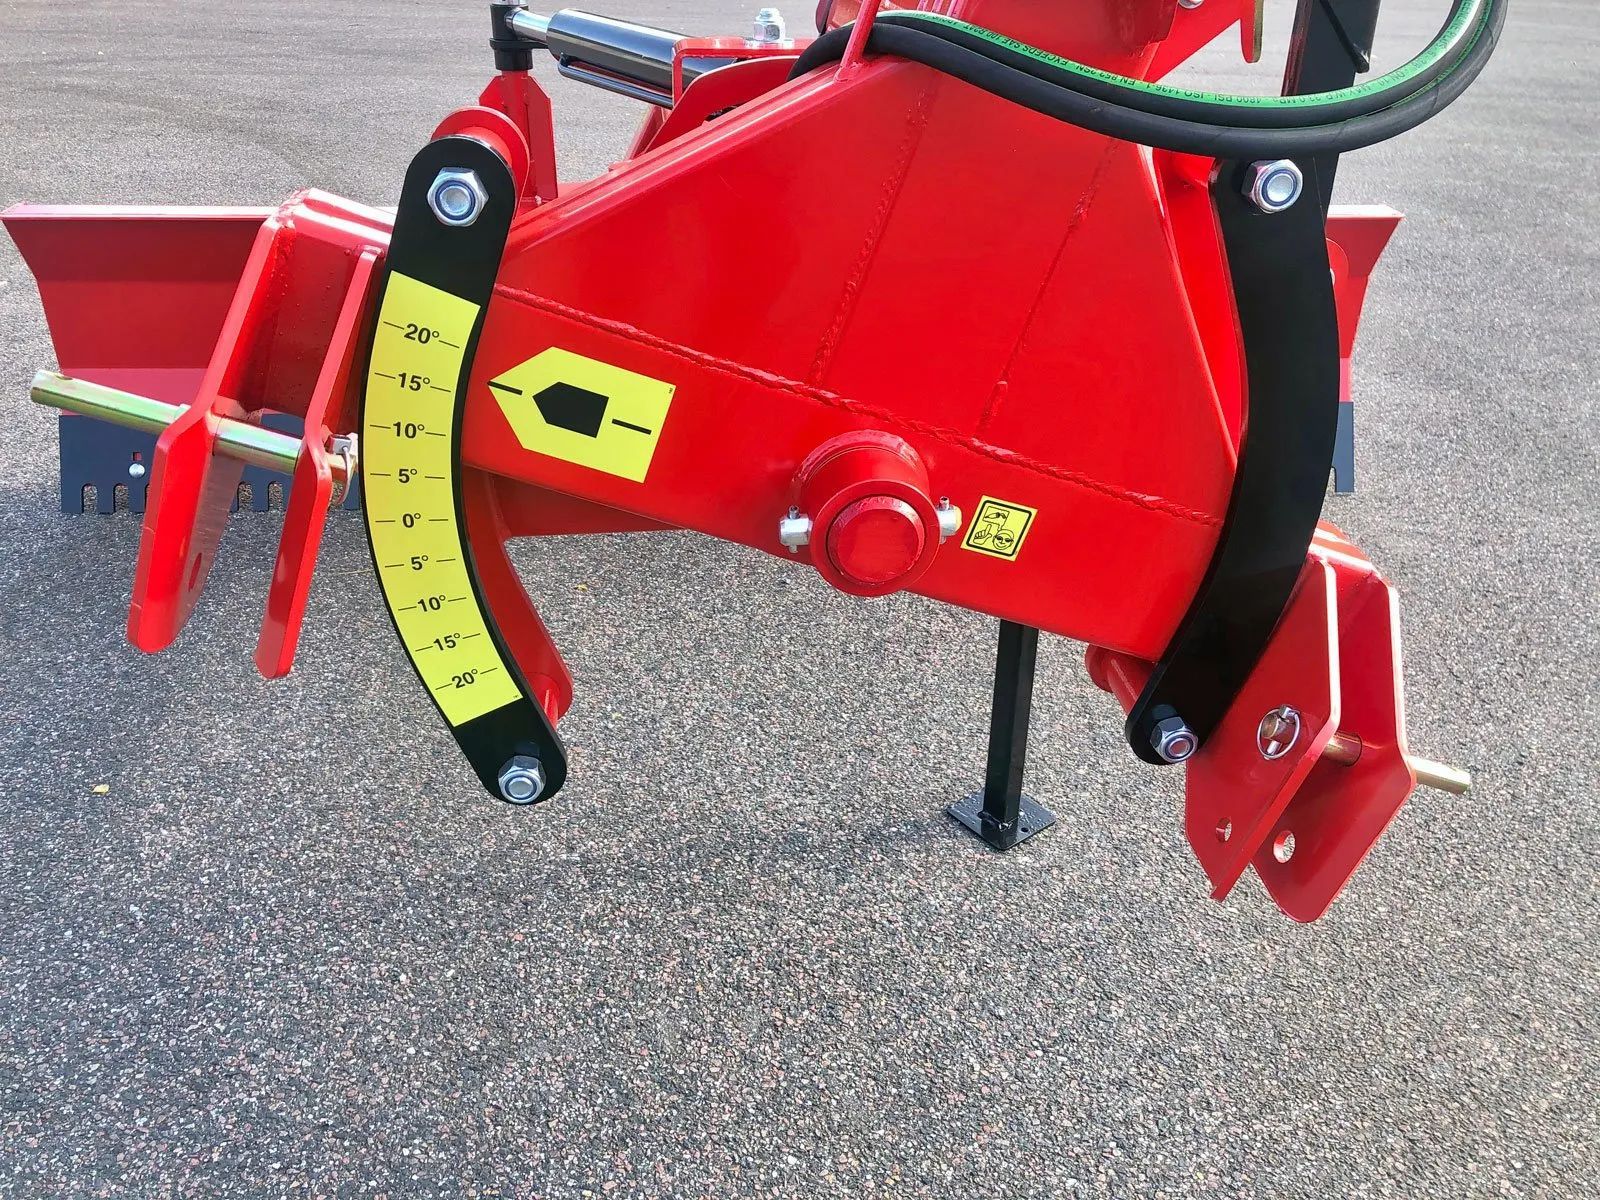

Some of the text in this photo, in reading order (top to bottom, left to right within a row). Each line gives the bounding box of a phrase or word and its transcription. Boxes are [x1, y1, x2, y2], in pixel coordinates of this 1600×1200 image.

[1002, 38, 1020, 49] SAE
[1022, 45, 1069, 66] EXCEEDS
[1184, 90, 1203, 99] ISO
[1214, 93, 1232, 102] PSI
[404, 323, 440, 344] 20°
[398, 372, 430, 391] 15°
[393, 421, 425, 438] 10°
[398, 468, 417, 484] 5°
[402, 513, 421, 528] 0°
[411, 554, 429, 571] 5°
[417, 594, 446, 612] 10°
[433, 632, 461, 651] 15°
[451, 669, 478, 689] 20°
